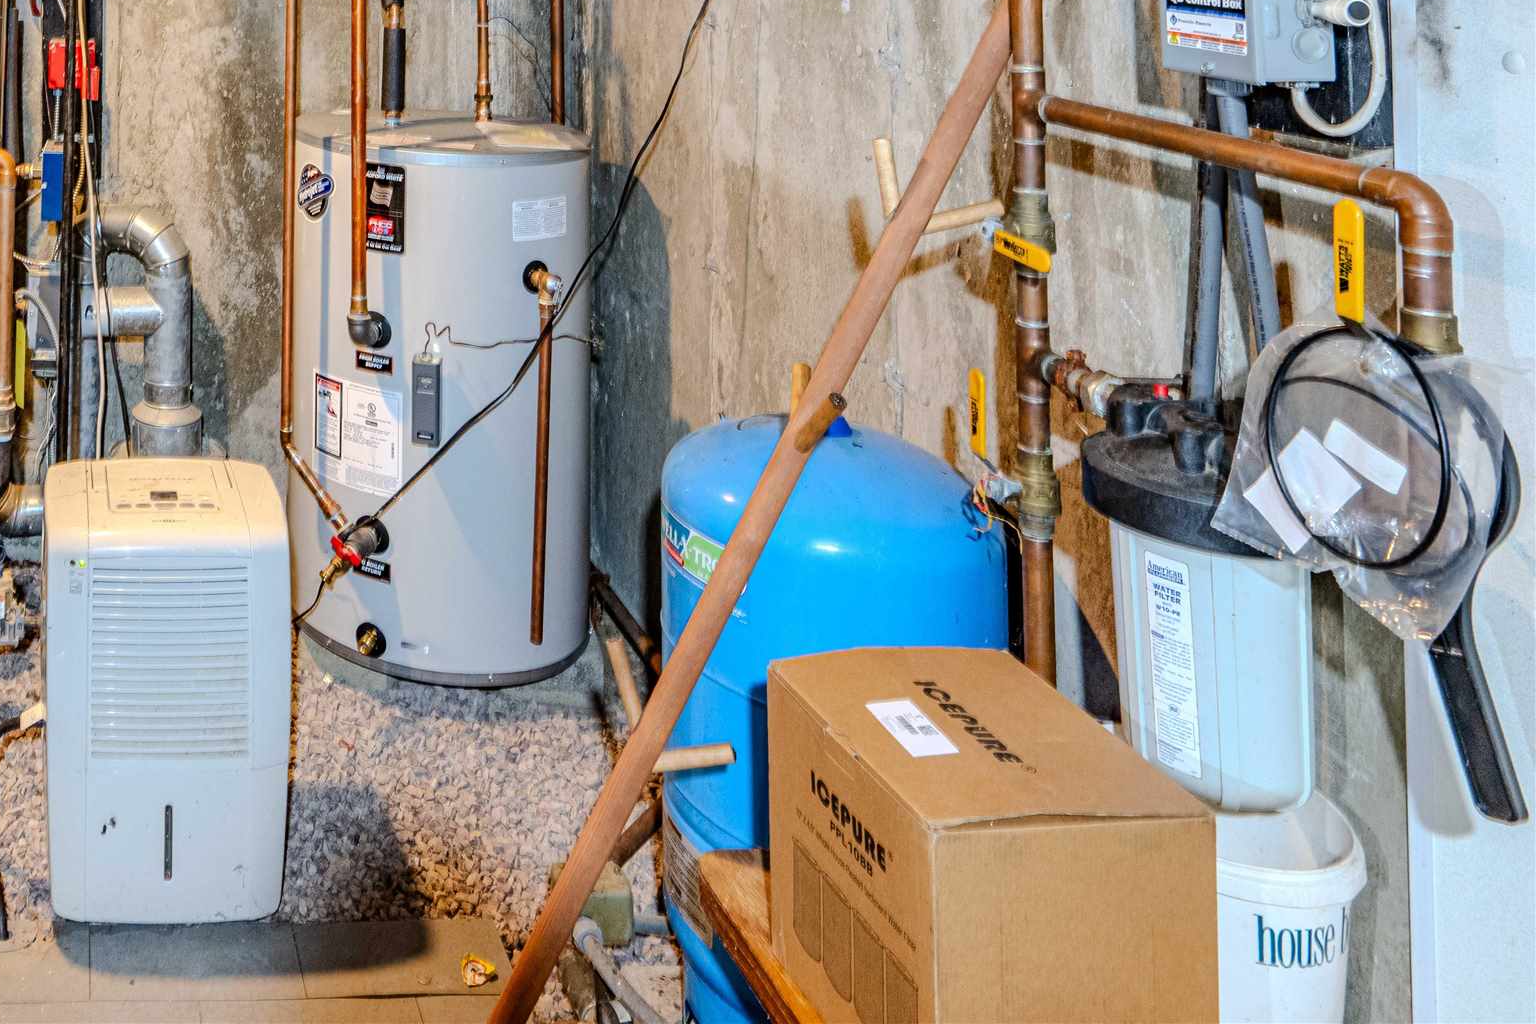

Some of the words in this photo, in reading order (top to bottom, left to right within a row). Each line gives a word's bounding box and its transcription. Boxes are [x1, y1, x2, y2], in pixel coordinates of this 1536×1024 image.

[1147, 560, 1183, 578] American
[1152, 583, 1181, 597] WATER
[1154, 591, 1182, 605] FILTER
[913, 679, 1023, 765] ICEPURE
[810, 769, 887, 872] ICEPURE
[1253, 913, 1336, 969] house
